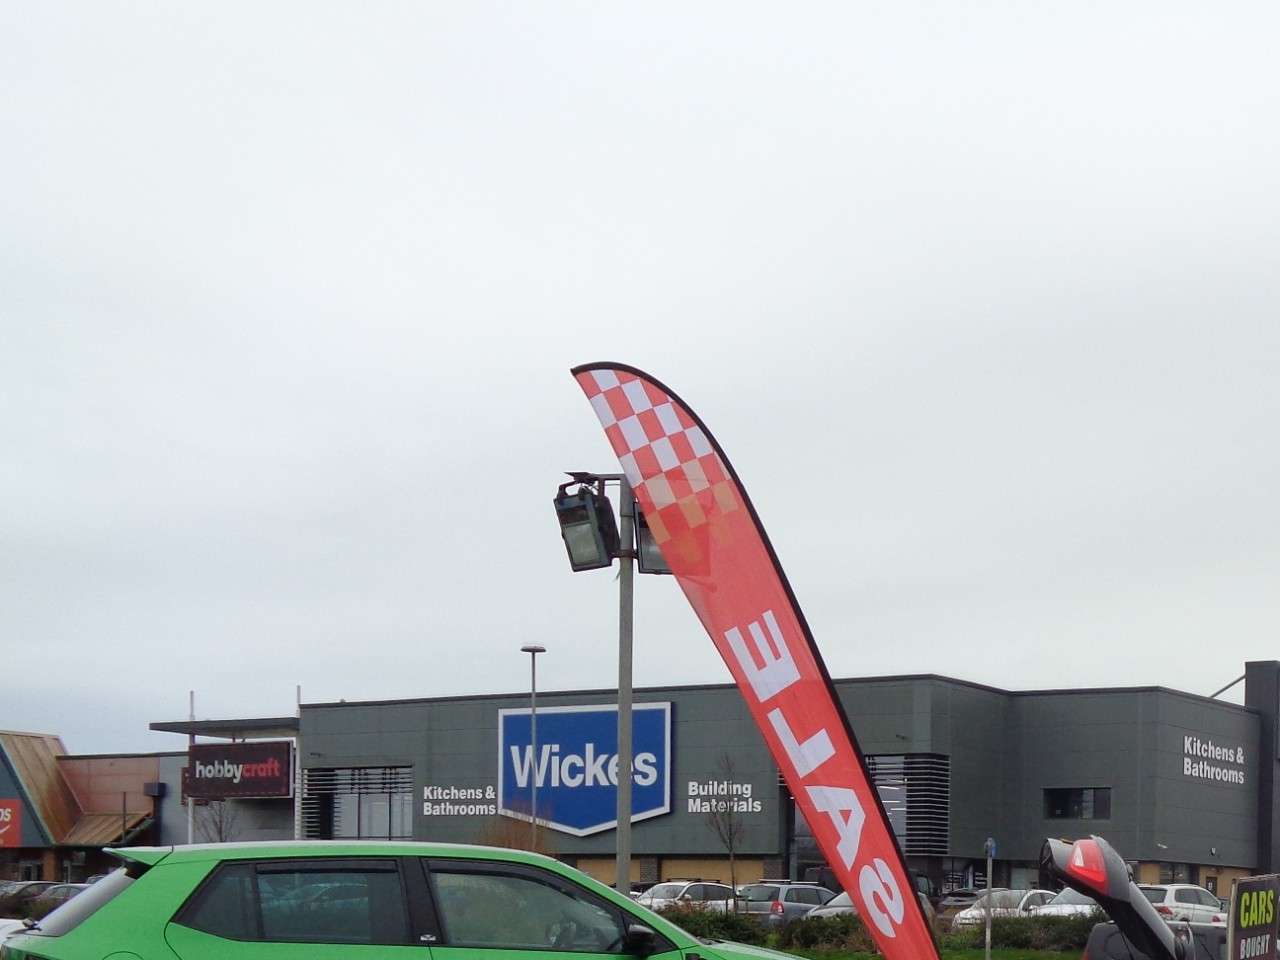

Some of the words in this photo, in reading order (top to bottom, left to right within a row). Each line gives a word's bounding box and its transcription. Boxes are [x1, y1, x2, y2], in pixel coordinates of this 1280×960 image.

[1184, 736, 1235, 762] Kitchens
[1236, 747, 1244, 764] &
[195, 758, 280, 783] hobbycraft
[510, 743, 657, 788] Wickes
[1184, 757, 1244, 784] Bathrooms
[424, 785, 483, 800] Kitchens
[485, 785, 496, 799] &
[688, 781, 752, 798] Building
[424, 801, 496, 816] Bathrooms
[688, 797, 762, 813] Materials
[1240, 890, 1274, 928] CARS
[1240, 934, 1271, 960] BOUGHT
